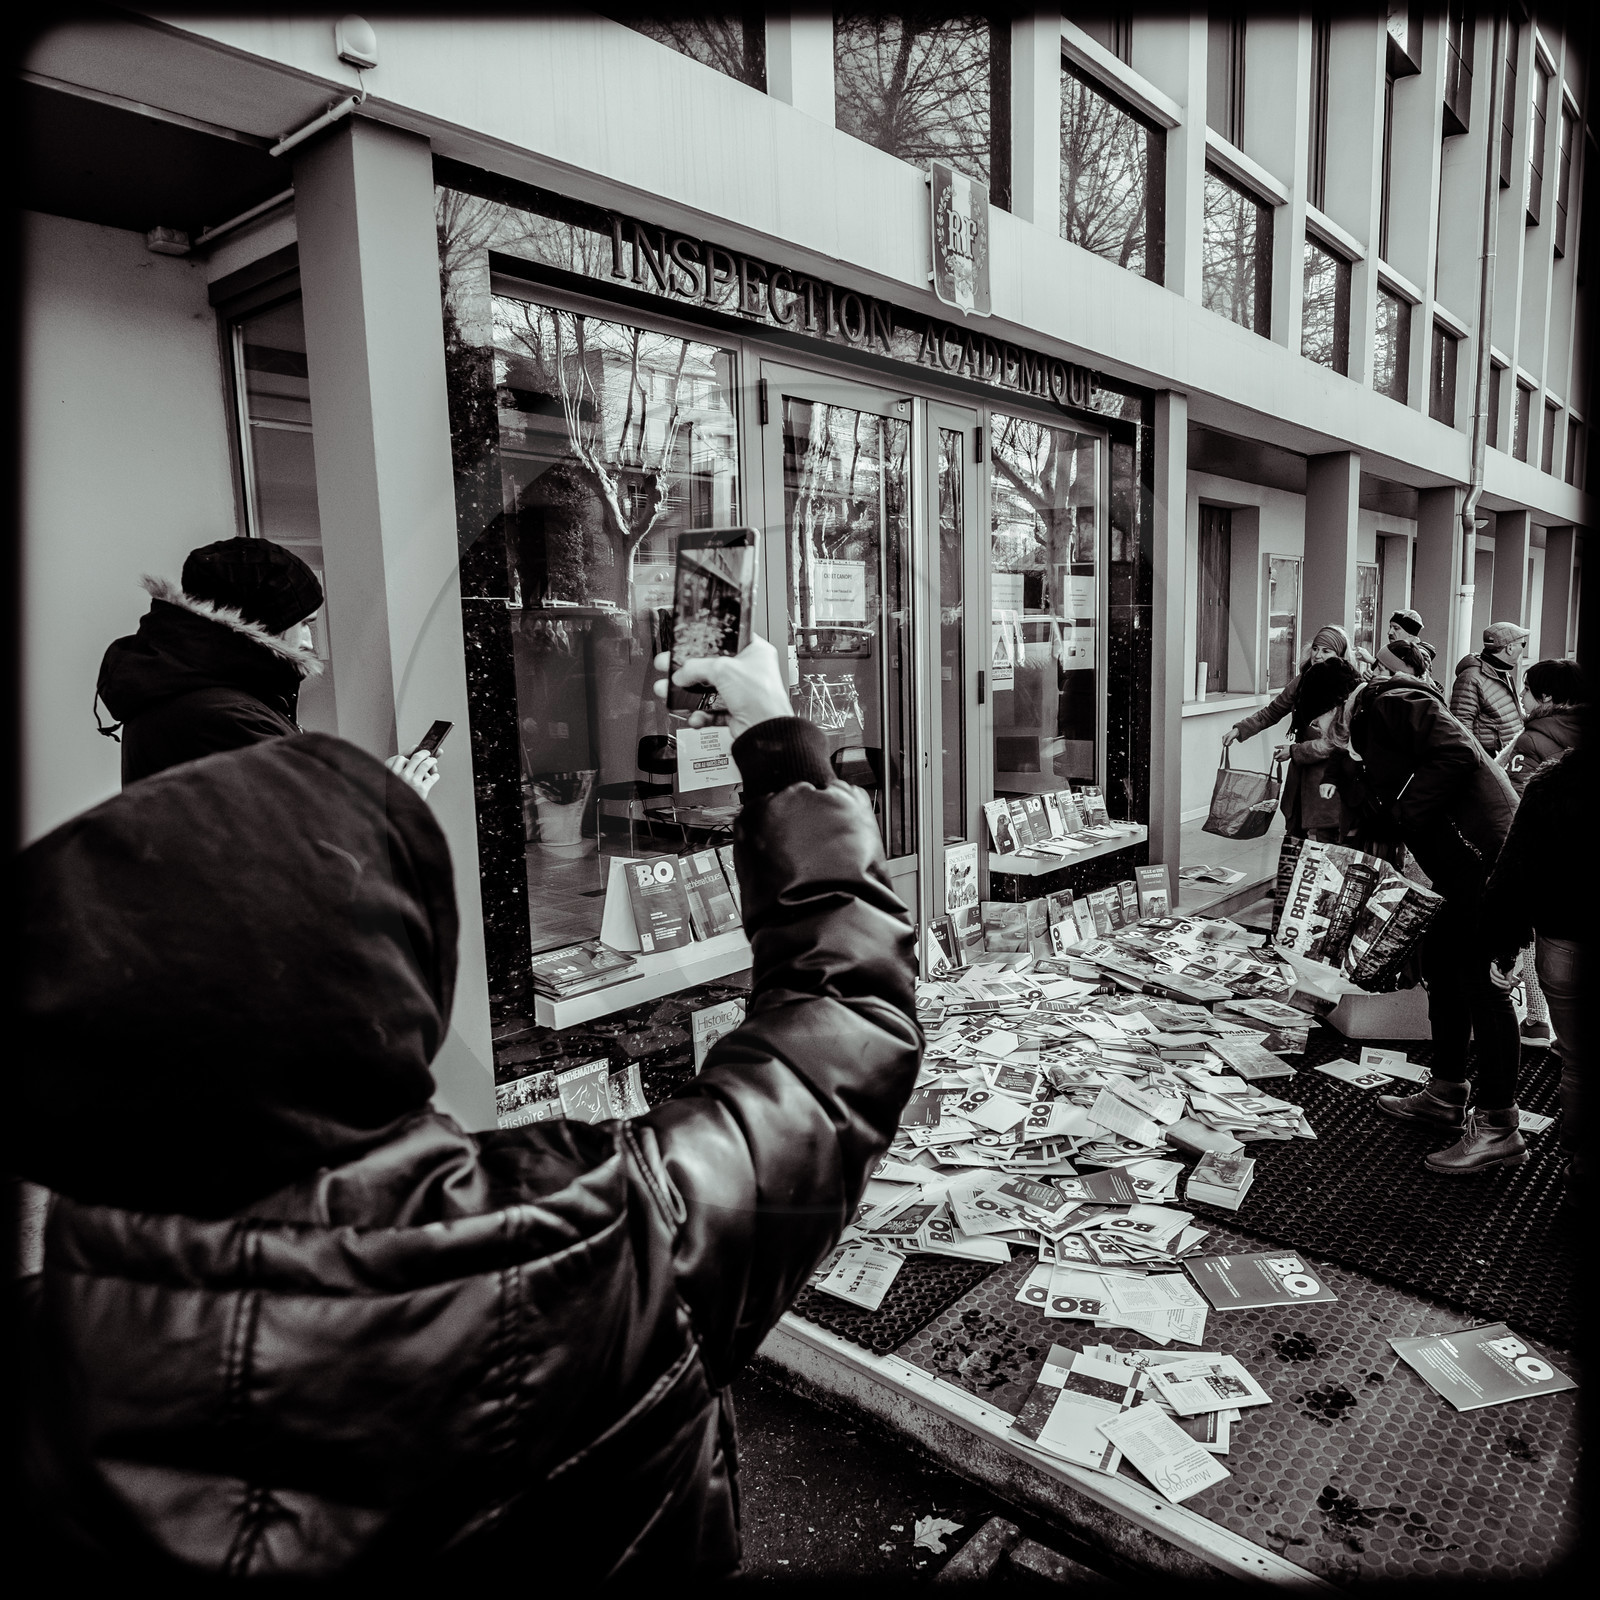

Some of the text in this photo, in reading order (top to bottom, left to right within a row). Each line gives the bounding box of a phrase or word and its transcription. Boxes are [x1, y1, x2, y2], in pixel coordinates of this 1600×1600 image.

[947, 209, 978, 260] RF
[609, 214, 1101, 411] INSPECTION ACADEMIQUE
[1281, 926, 1299, 948] SO
[1290, 857, 1320, 920] BRITISH
[697, 1010, 733, 1031] Histoire
[1067, 1014, 1097, 1023] BO
[964, 1028, 994, 1044] BO
[557, 1060, 609, 1085] MATHEMATIQUES
[957, 1090, 990, 1114] BO
[498, 1108, 545, 1131] Histoire
[1027, 1104, 1051, 1129] BO
[1059, 1179, 1090, 1199] BO
[928, 1218, 951, 1242] BO
[1110, 1219, 1156, 1234] BO
[1052, 1296, 1101, 1316] BO
[1166, 1468, 1212, 1496] Mutations
